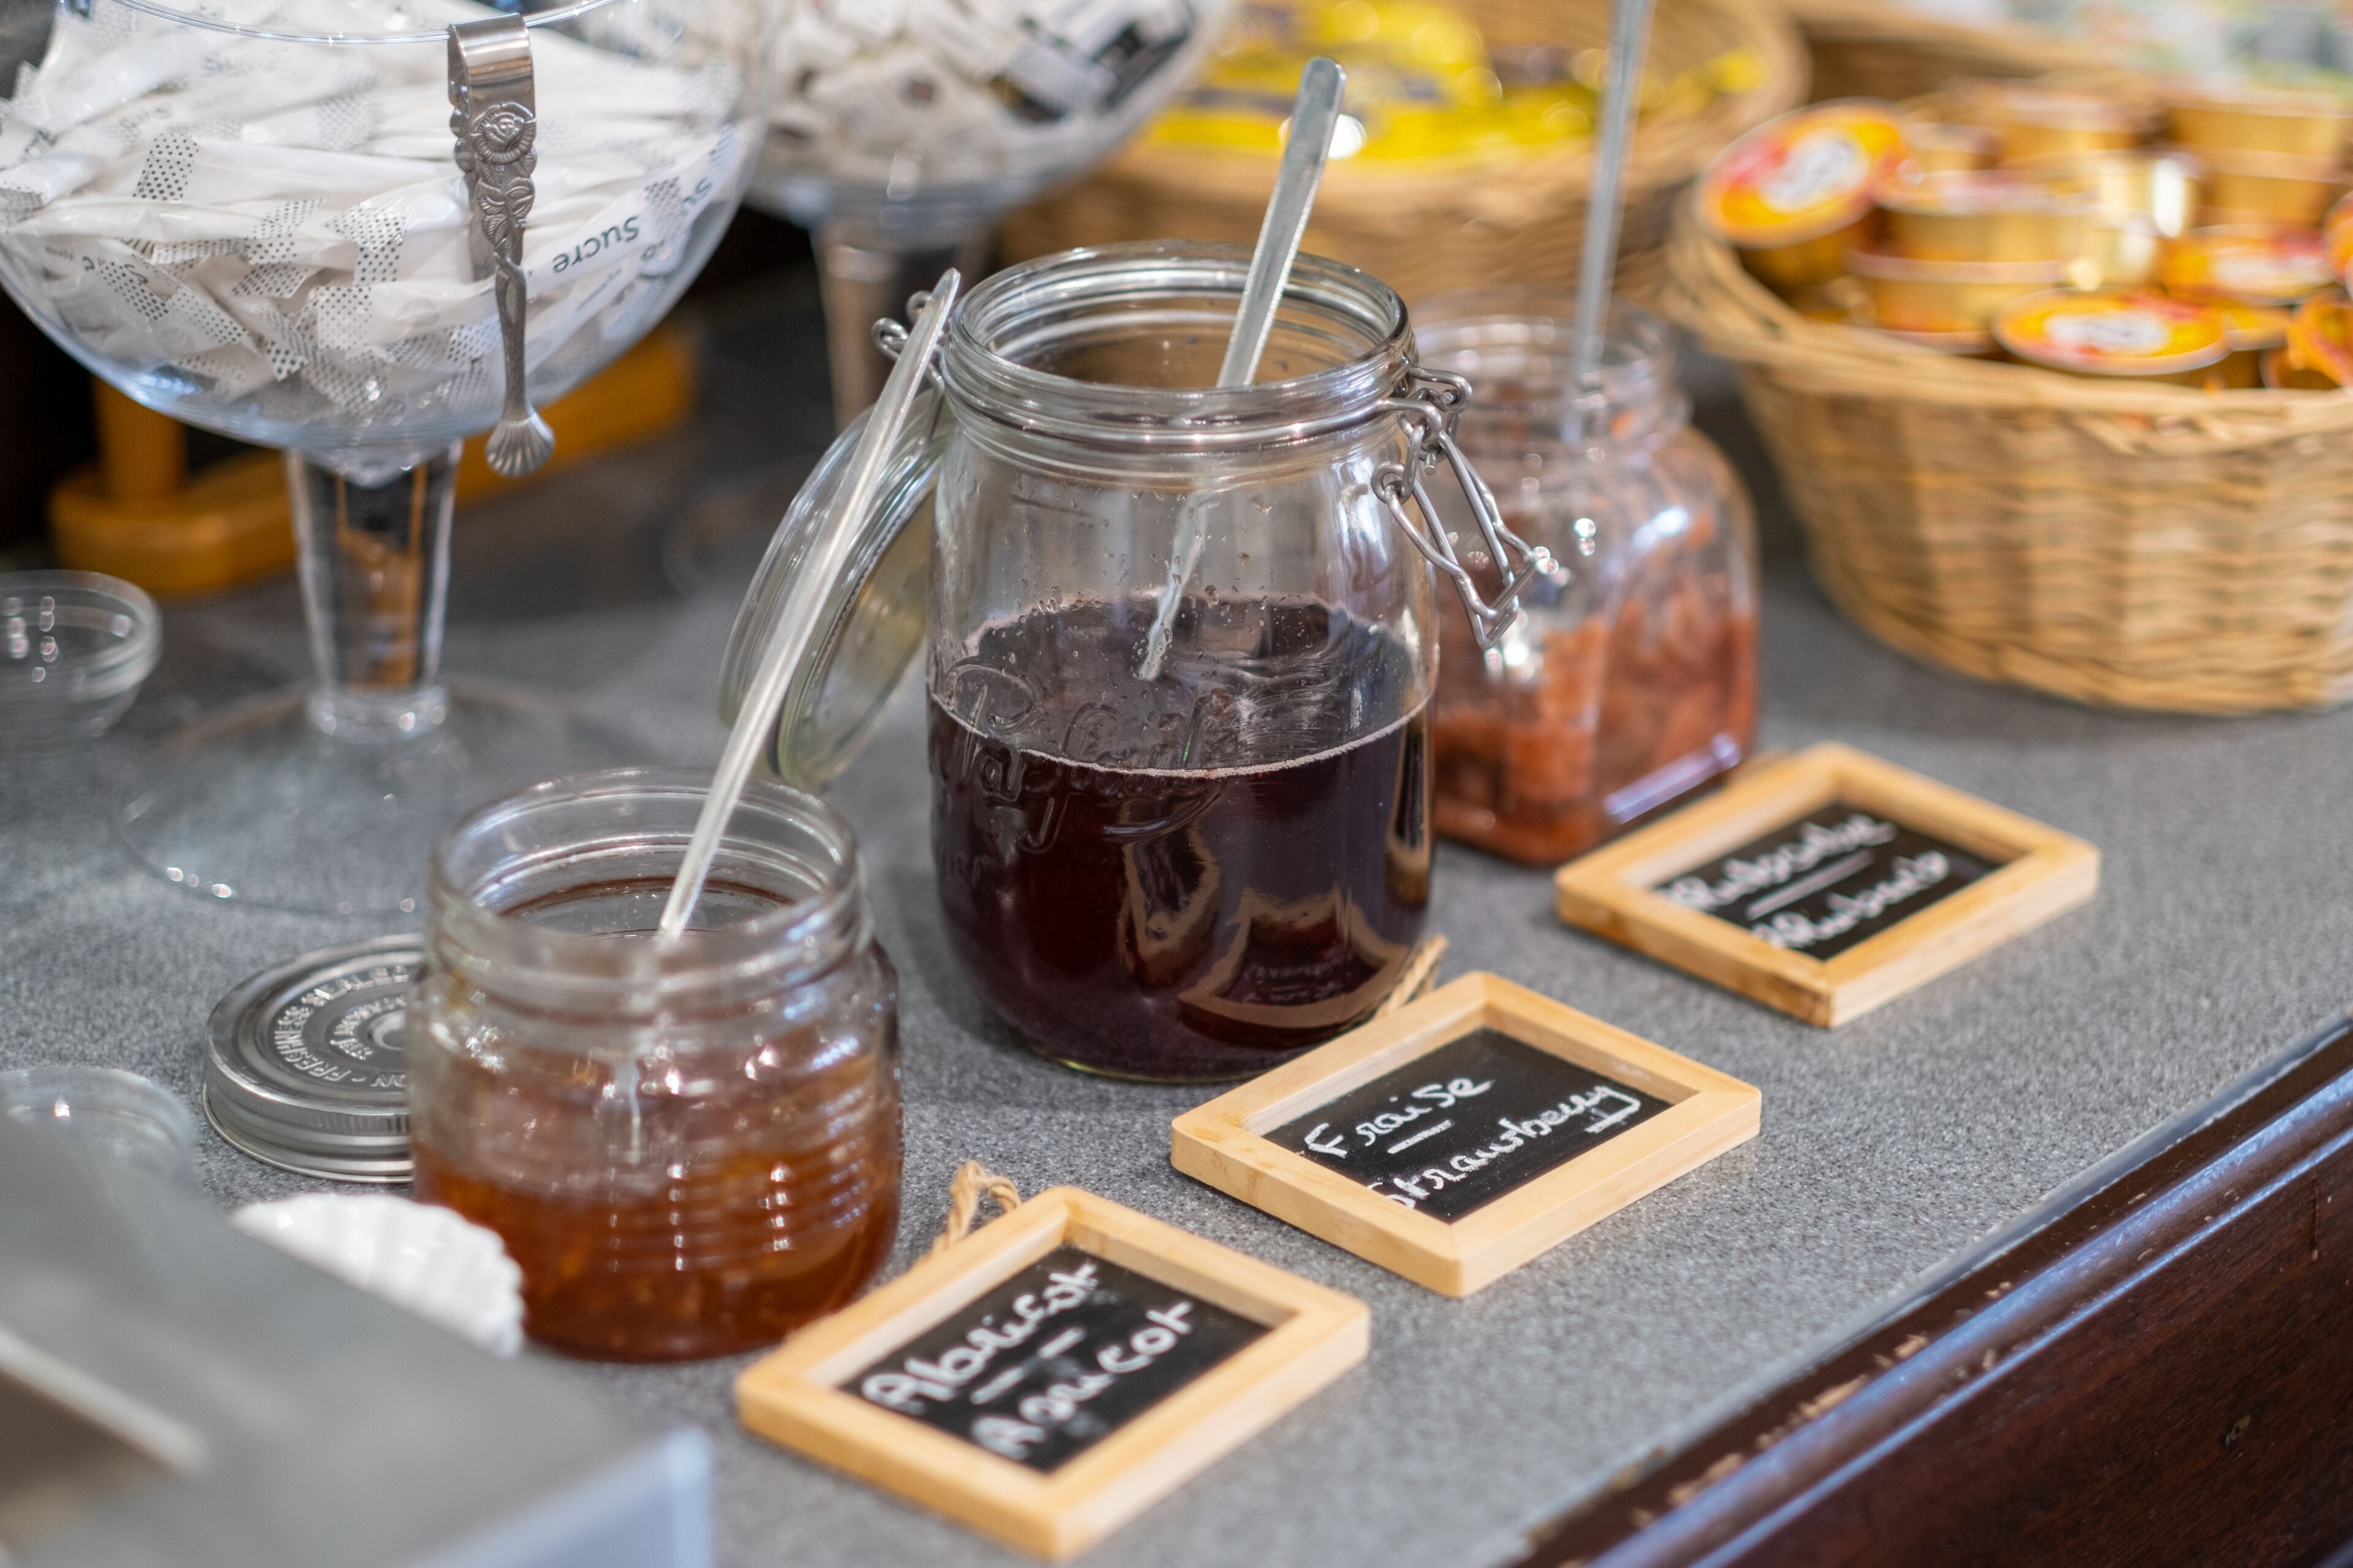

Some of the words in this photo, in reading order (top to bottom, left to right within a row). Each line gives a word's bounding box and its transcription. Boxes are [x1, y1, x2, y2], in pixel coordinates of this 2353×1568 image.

[553, 216, 640, 274] Sucre
[274, 1006, 352, 1081] FRESHNESS
[1303, 1077, 1495, 1158] Fraise
[861, 1263, 1099, 1414] Abricot
